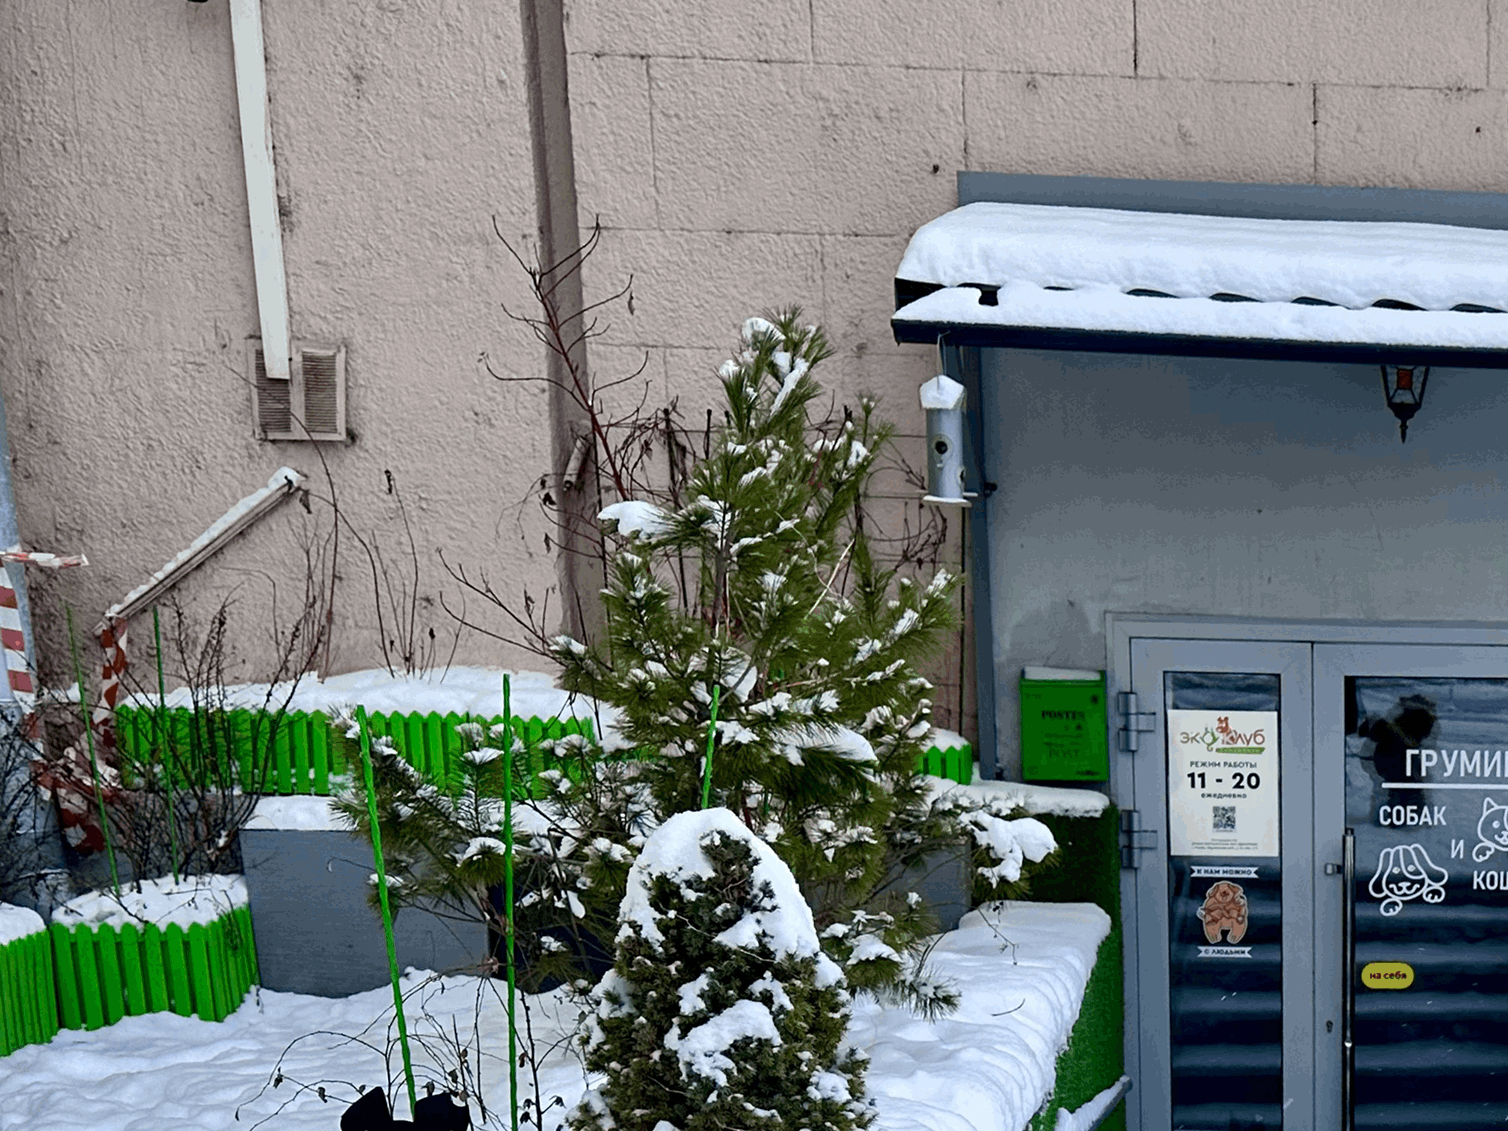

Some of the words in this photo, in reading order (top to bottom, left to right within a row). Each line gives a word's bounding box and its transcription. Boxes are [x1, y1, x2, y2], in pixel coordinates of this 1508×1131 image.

[1189, 760, 1221, 769] РЕЖИМ
[1223, 760, 1258, 769] РАБОТЫ
[1186, 771, 1206, 789] 11
[1231, 772, 1261, 789] 20
[1379, 805, 1448, 827] СОБАК
[1450, 838, 1465, 860] И
[1203, 868, 1221, 876] НАМ
[1369, 972, 1382, 980] на
[1382, 970, 1408, 980] себя
